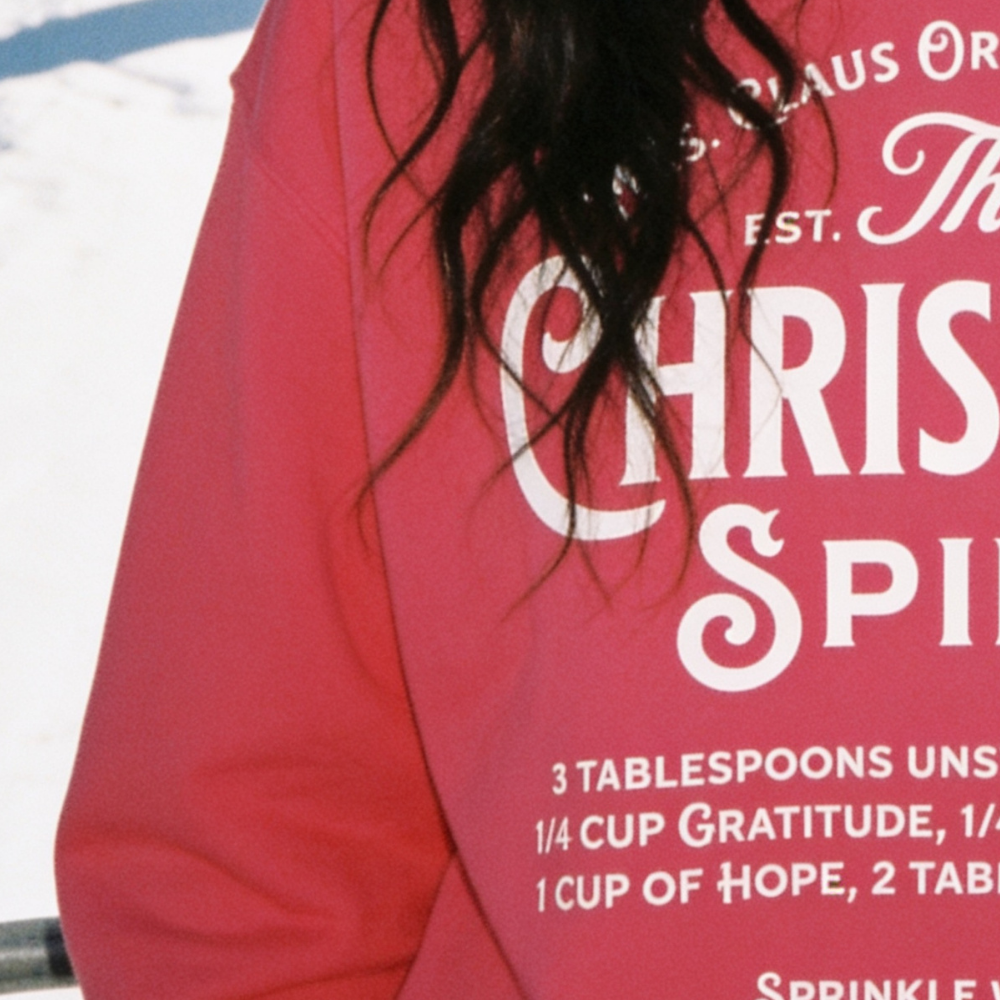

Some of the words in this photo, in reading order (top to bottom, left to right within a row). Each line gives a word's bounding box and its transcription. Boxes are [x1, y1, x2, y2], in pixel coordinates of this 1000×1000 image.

[552, 763, 567, 795] 3
[576, 745, 893, 792] TABLESPOONS
[535, 816, 572, 854] 1/4
[580, 812, 665, 850] CUP
[678, 802, 946, 848] GRATITUDE,
[535, 878, 546, 913] 1
[555, 873, 630, 910] CUP
[642, 868, 703, 906] OF
[717, 861, 857, 904] HOPE,
[871, 860, 896, 895] 2
